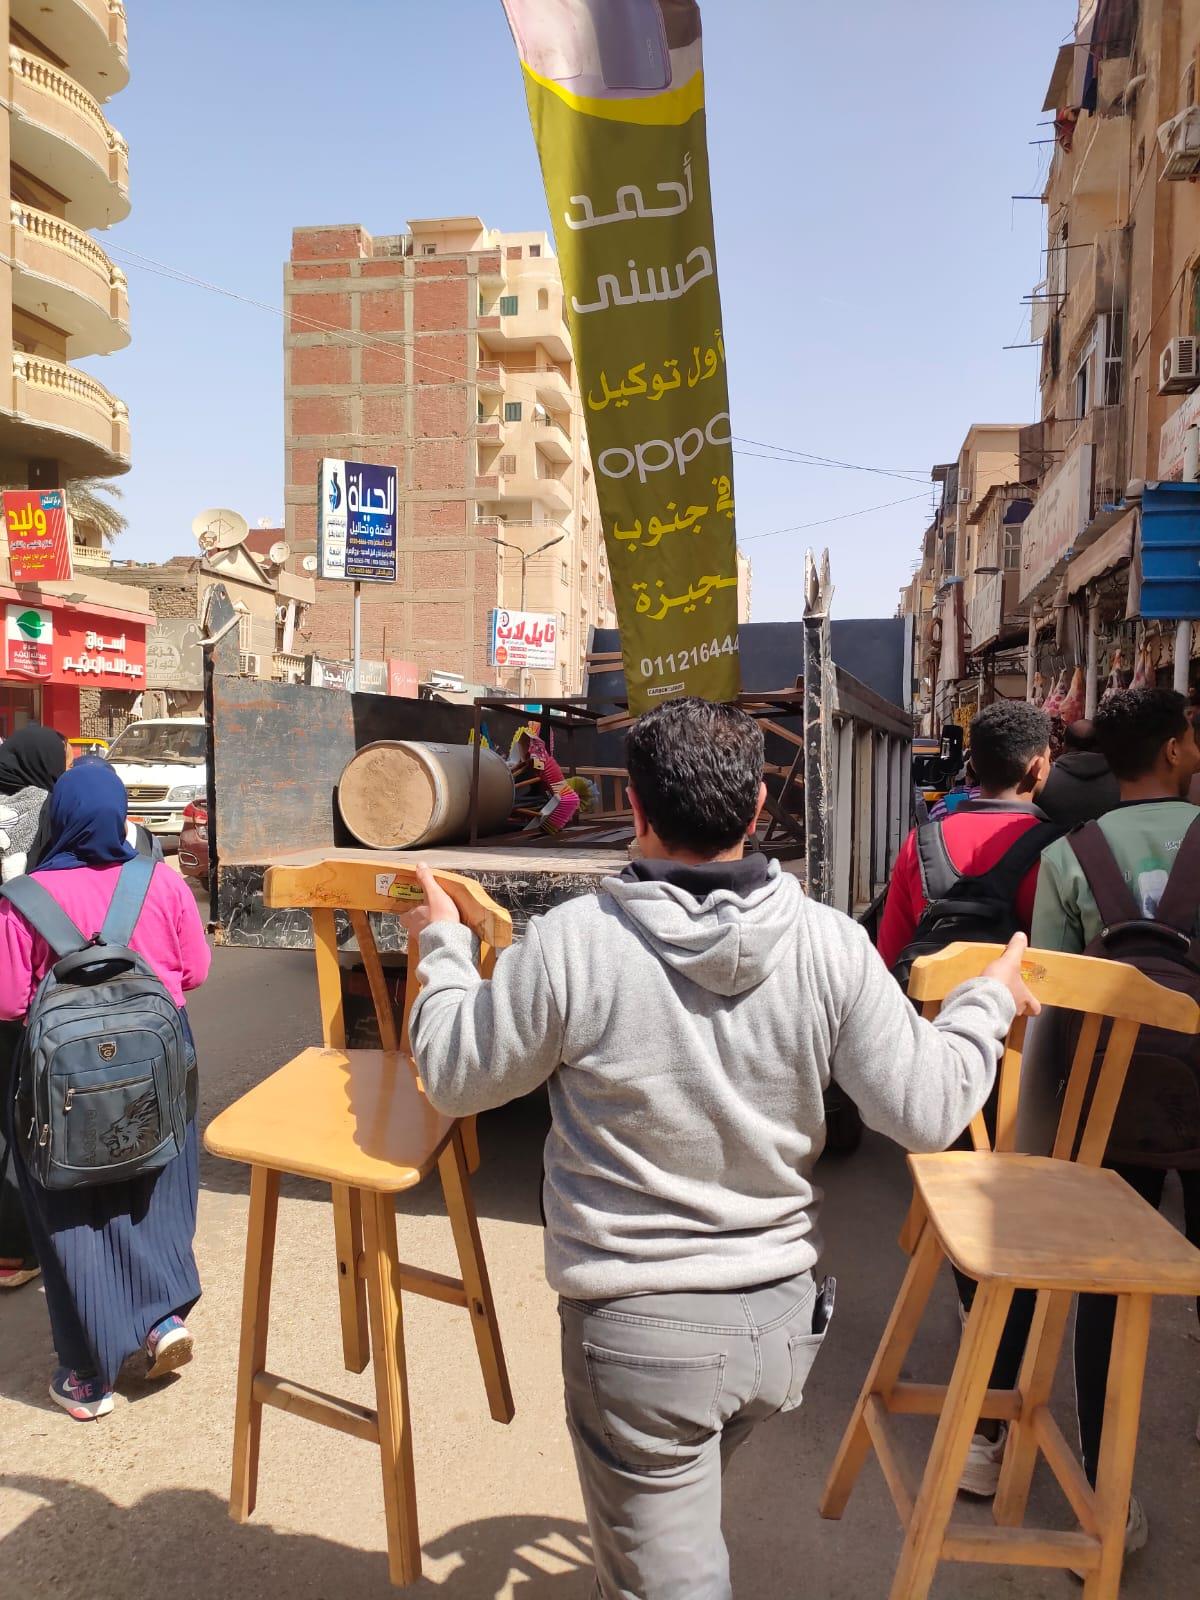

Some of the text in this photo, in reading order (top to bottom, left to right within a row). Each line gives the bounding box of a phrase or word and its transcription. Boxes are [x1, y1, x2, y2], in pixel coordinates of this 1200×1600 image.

[564, 152, 694, 231] أحمد
[588, 328, 726, 410] أول توكيل
[8, 503, 46, 536] وليد
[347, 472, 395, 521] الحياة
[613, 502, 709, 552] جنوب
